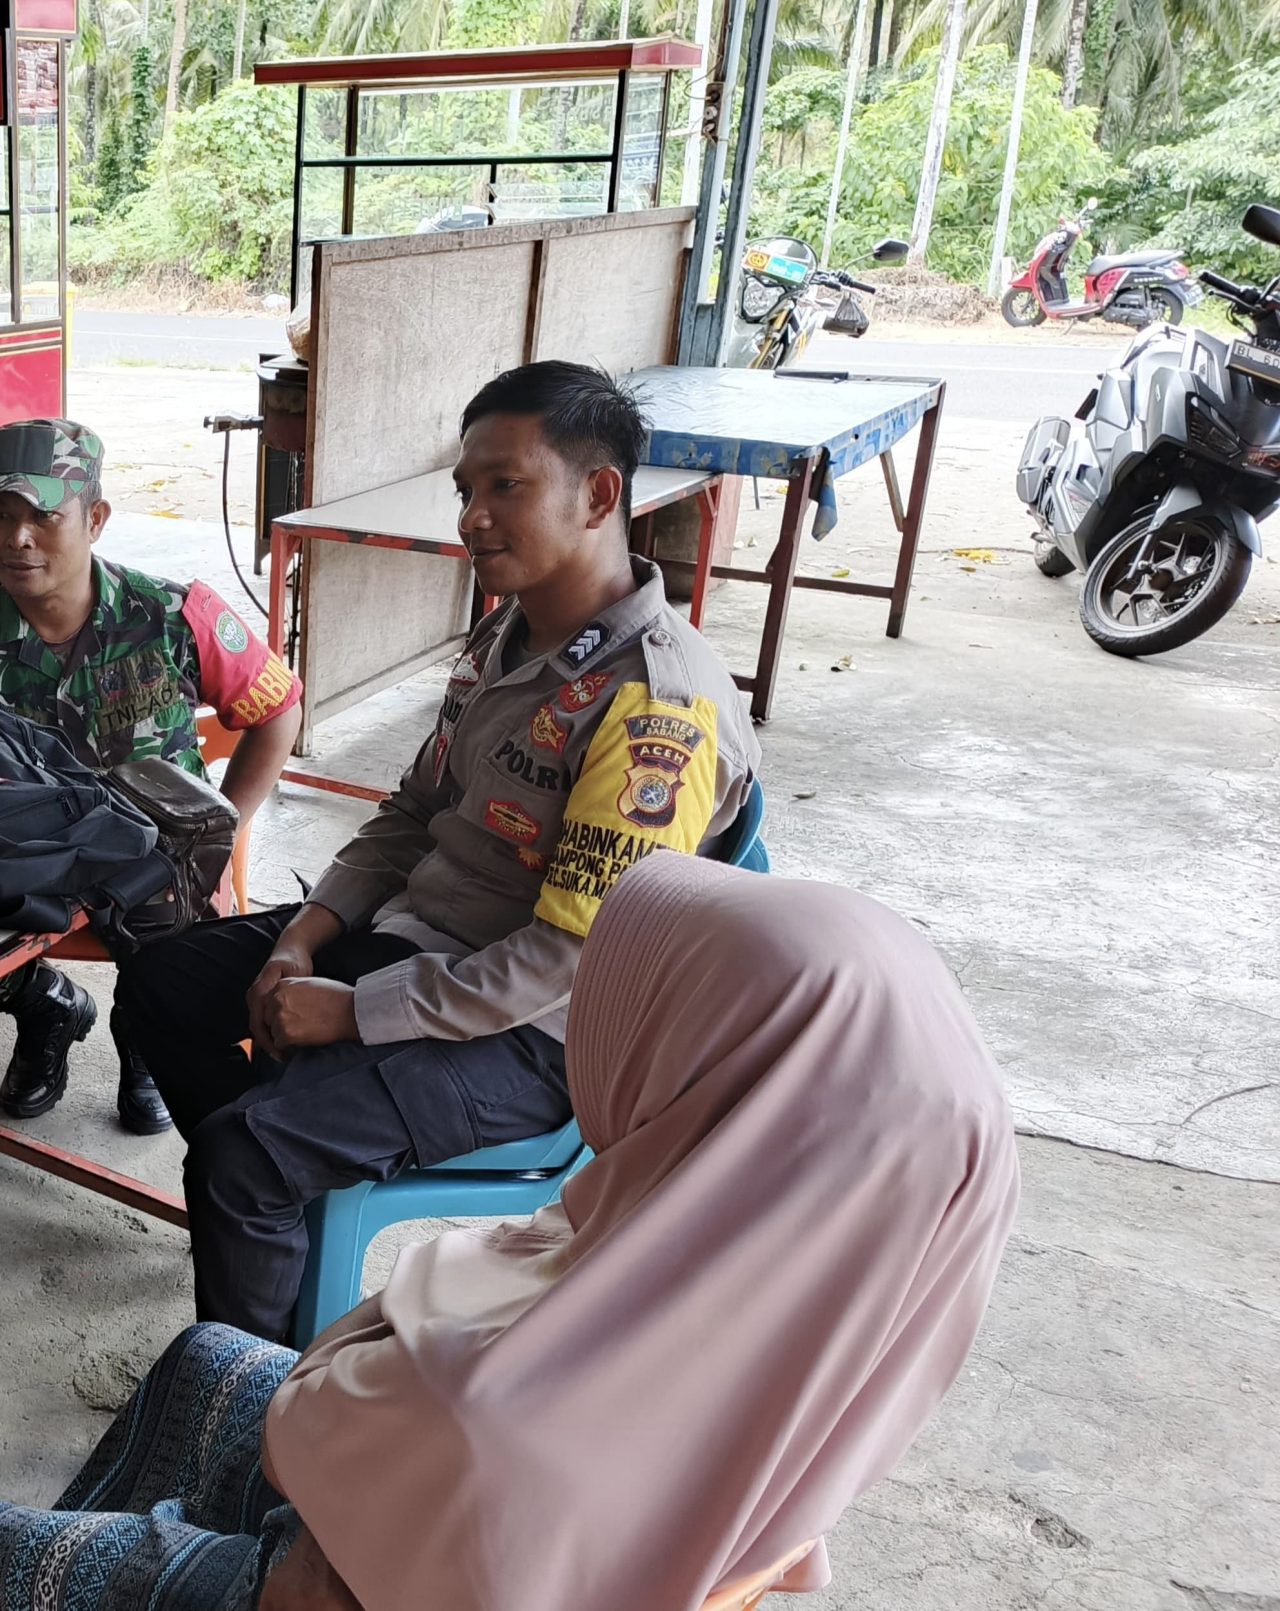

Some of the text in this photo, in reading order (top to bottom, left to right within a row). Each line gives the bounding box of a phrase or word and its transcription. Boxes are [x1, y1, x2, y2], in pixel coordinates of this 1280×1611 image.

[231, 652, 294, 723] BABIN
[102, 688, 173, 729] TNI-AD
[639, 718, 696, 738] POLRES
[646, 727, 687, 741] SABANG
[640, 745, 685, 765] ACEH
